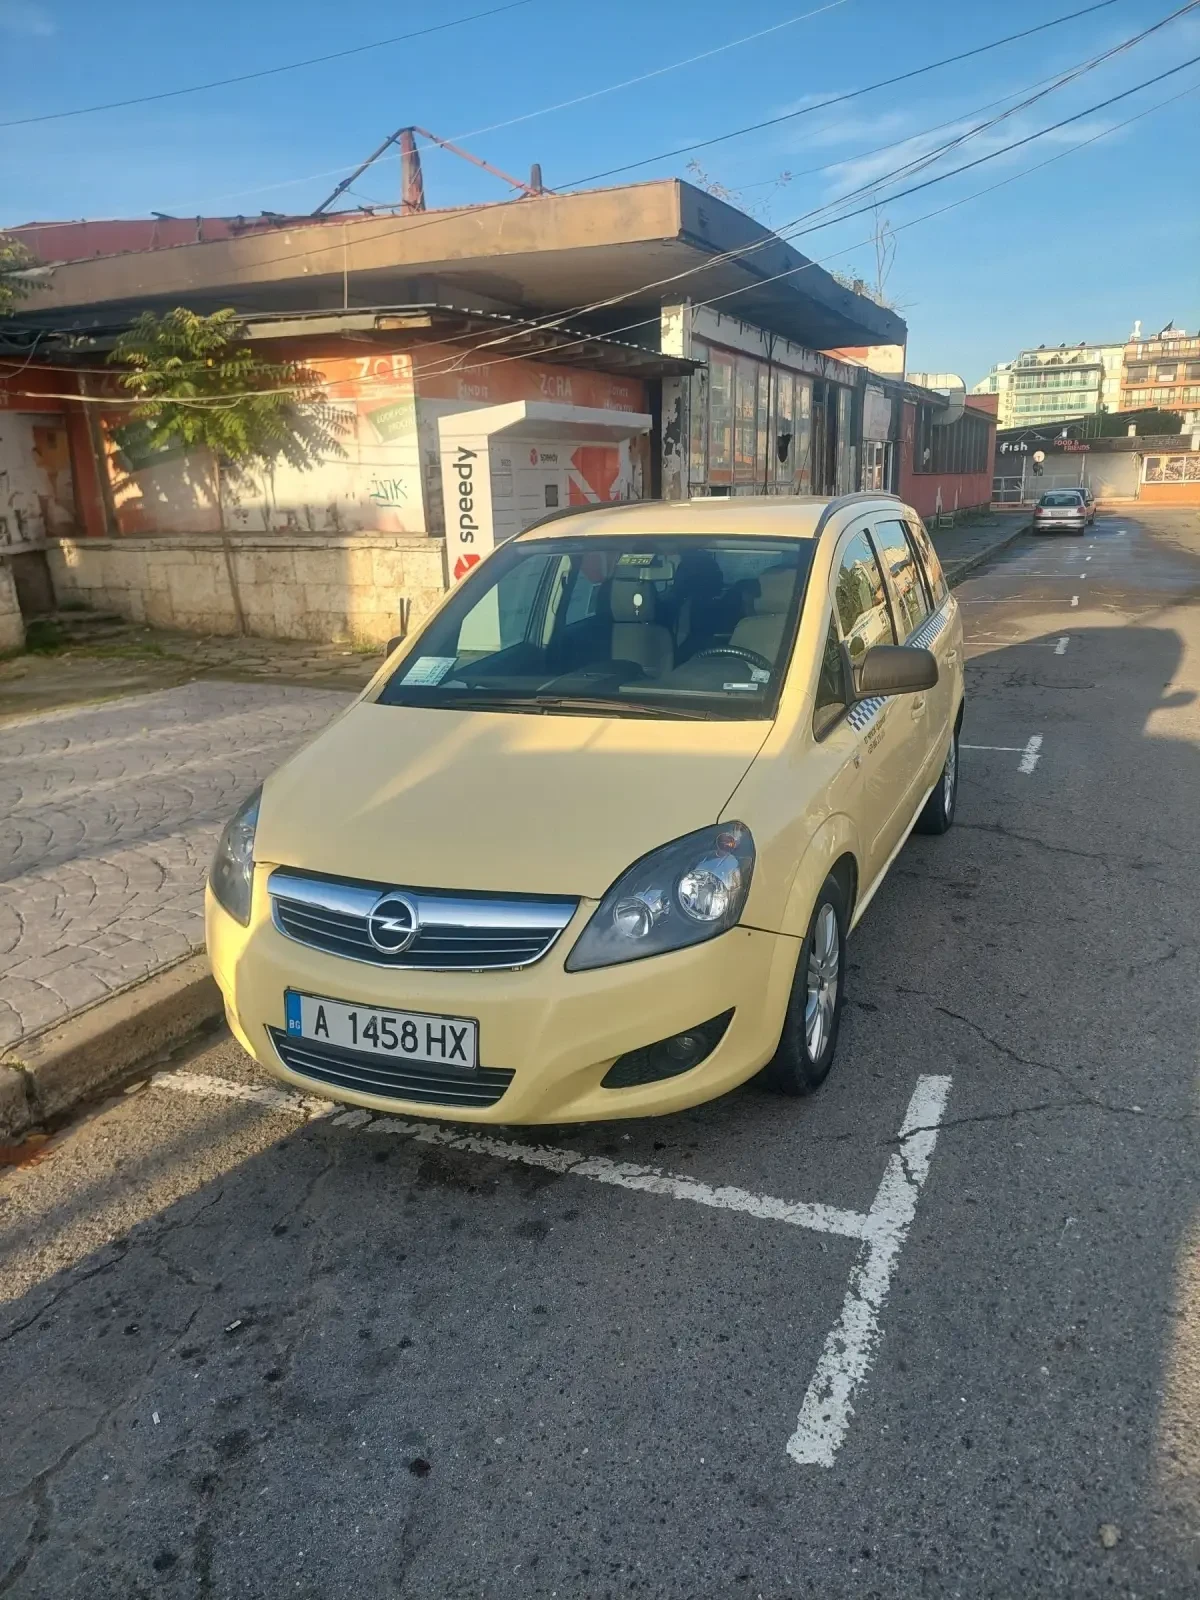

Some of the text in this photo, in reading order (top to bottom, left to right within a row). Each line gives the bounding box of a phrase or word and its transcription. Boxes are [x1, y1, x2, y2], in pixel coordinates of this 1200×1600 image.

[453, 446, 478, 543] speedy
[289, 1019, 301, 1029] BG
[314, 1005, 468, 1061] A 1458 HX
